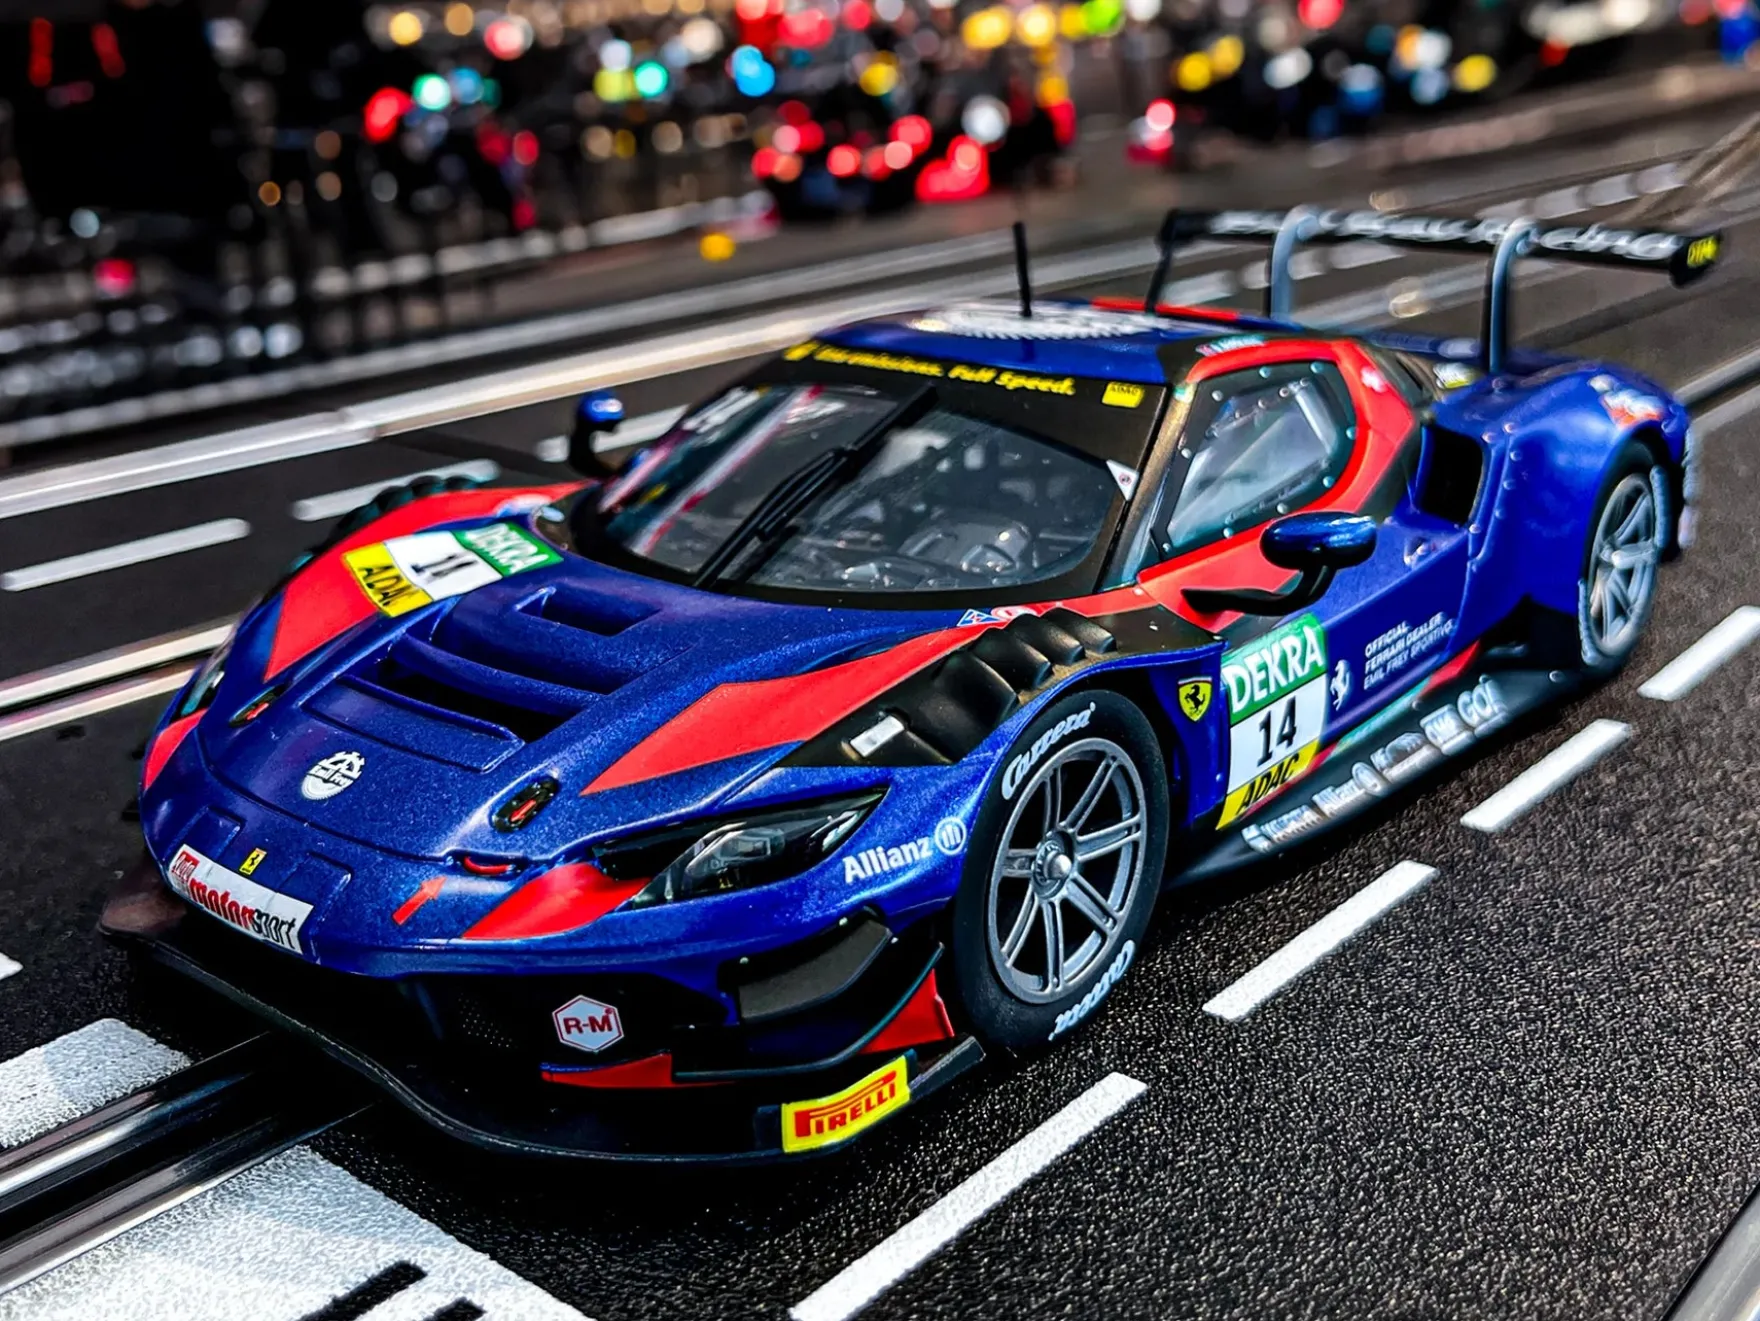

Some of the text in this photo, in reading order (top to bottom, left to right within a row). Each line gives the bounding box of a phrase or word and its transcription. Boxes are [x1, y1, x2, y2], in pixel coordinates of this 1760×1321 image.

[1221, 625, 1325, 714] DEKRA
[1365, 620, 1411, 658] OFFICIAL
[1256, 696, 1297, 767] 14
[1235, 752, 1300, 815] ADAC
[842, 836, 935, 884] Allianz
[794, 1069, 897, 1138] PIRELLI
